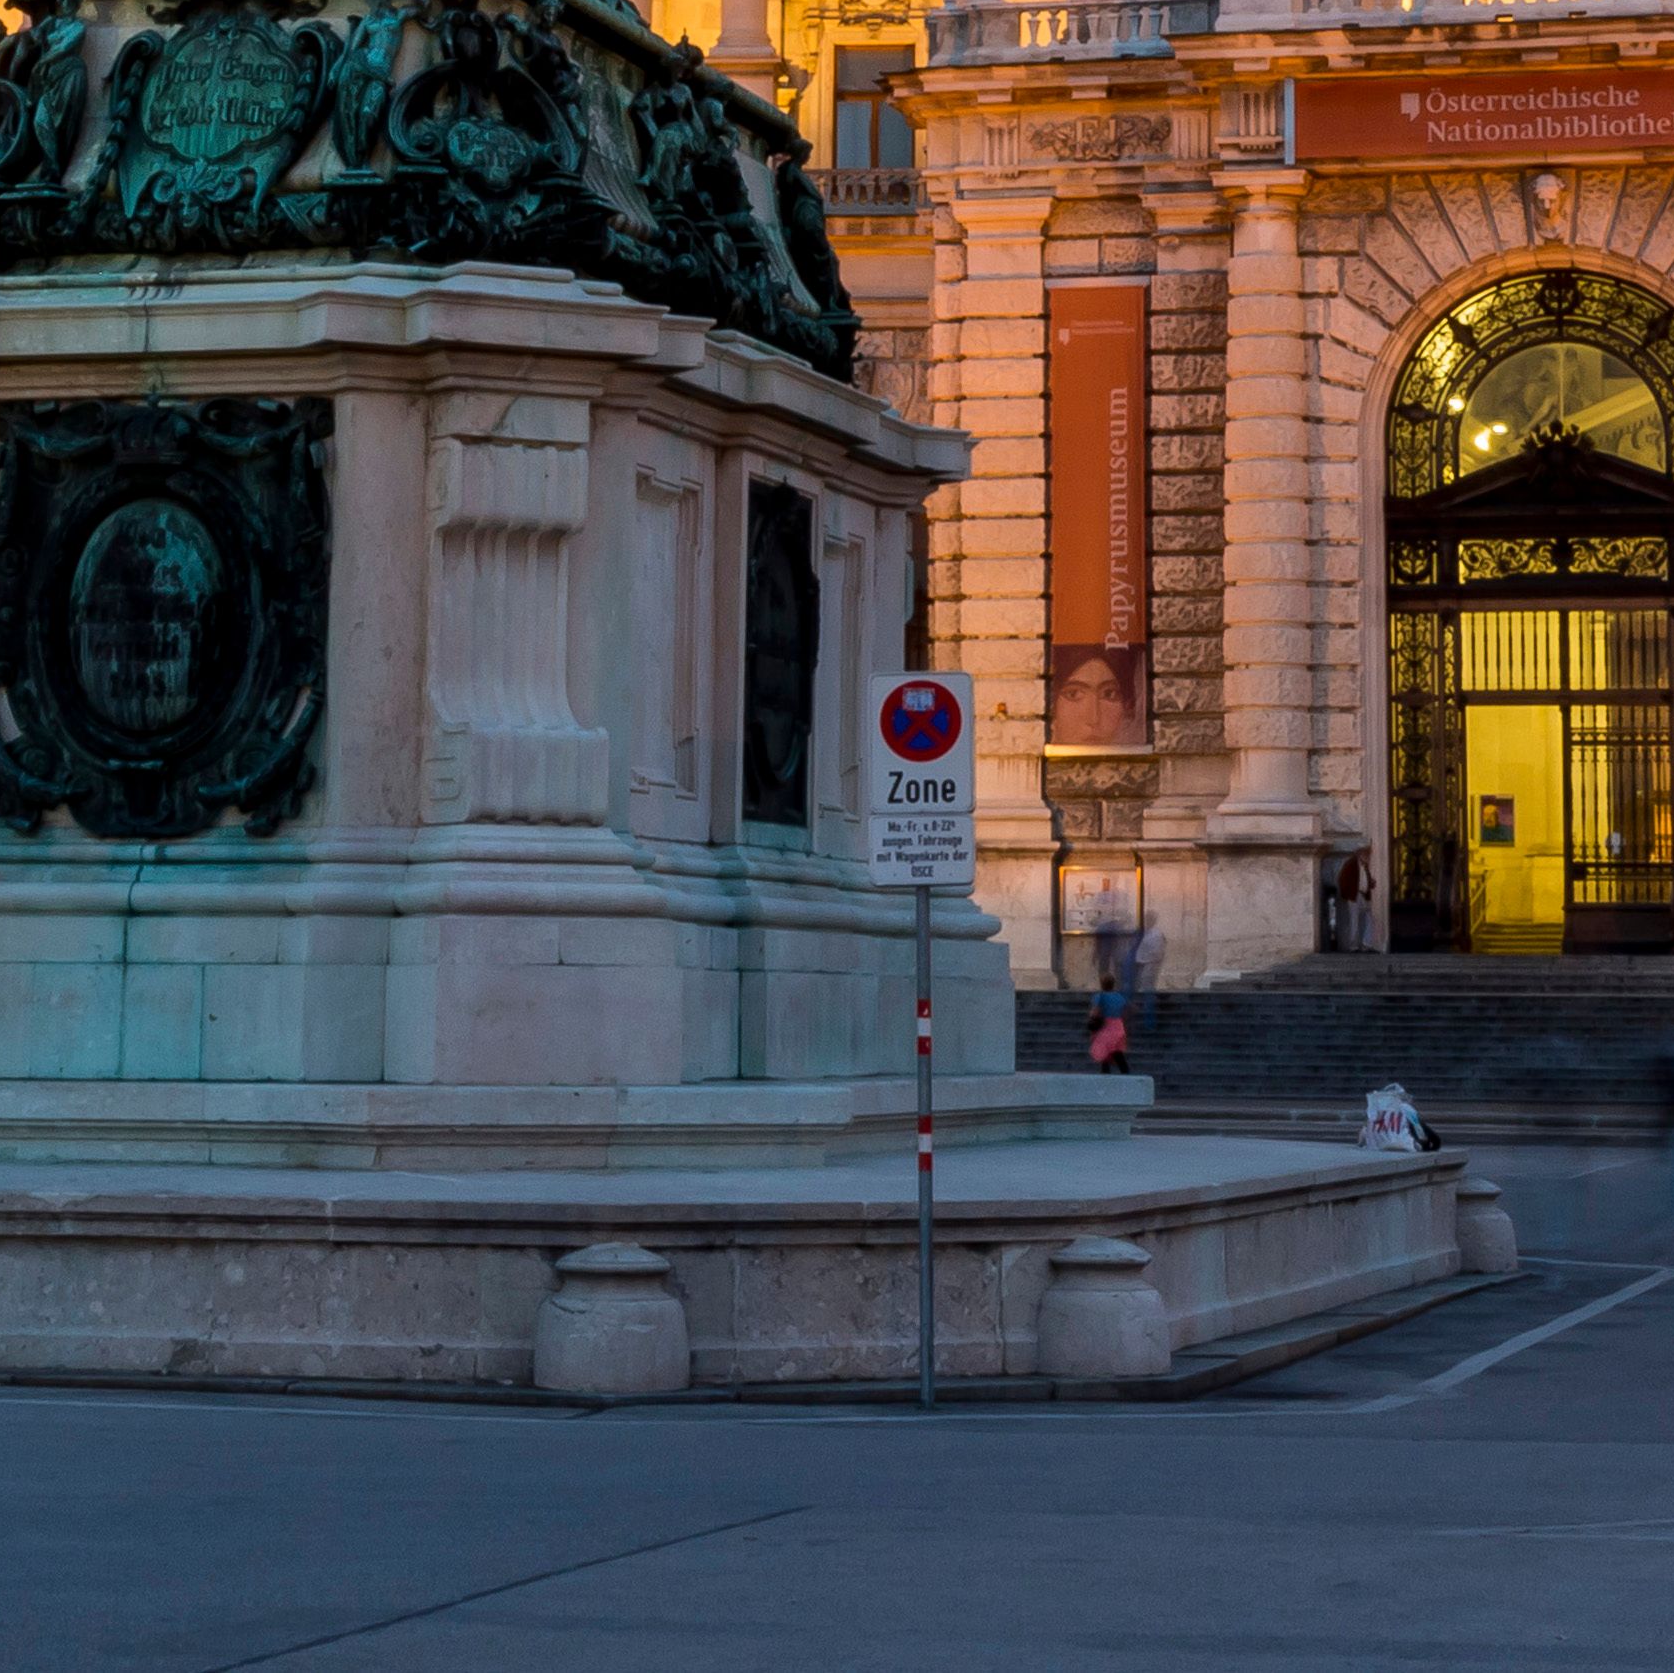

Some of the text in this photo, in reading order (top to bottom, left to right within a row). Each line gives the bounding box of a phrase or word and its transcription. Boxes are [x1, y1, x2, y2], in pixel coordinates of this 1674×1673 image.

[1425, 85, 1641, 114] Österreichische
[1105, 387, 1136, 651] Papyrusmuseum
[887, 771, 956, 804] Zone
